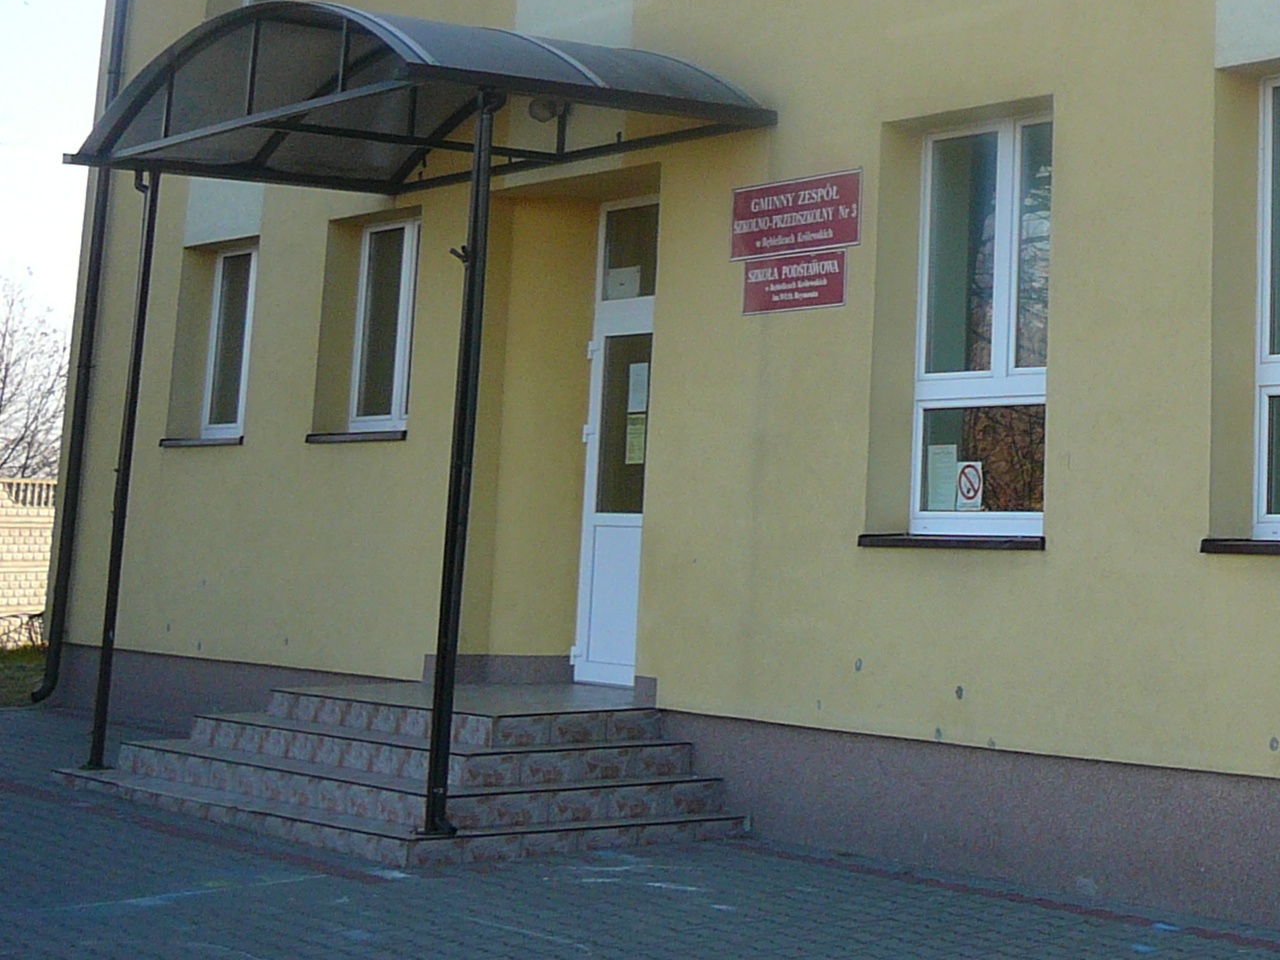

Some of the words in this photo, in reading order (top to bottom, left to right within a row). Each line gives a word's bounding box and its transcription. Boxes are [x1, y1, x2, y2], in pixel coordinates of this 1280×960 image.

[751, 192, 795, 212] GMINNY
[798, 183, 840, 205] ZESPÓŁ
[733, 207, 834, 234] SZKOLNO-PRZEDSZKOLNY
[838, 205, 850, 219] Nr
[747, 268, 779, 283] SZKOŁA
[781, 260, 839, 279] PODSTAWOWA
